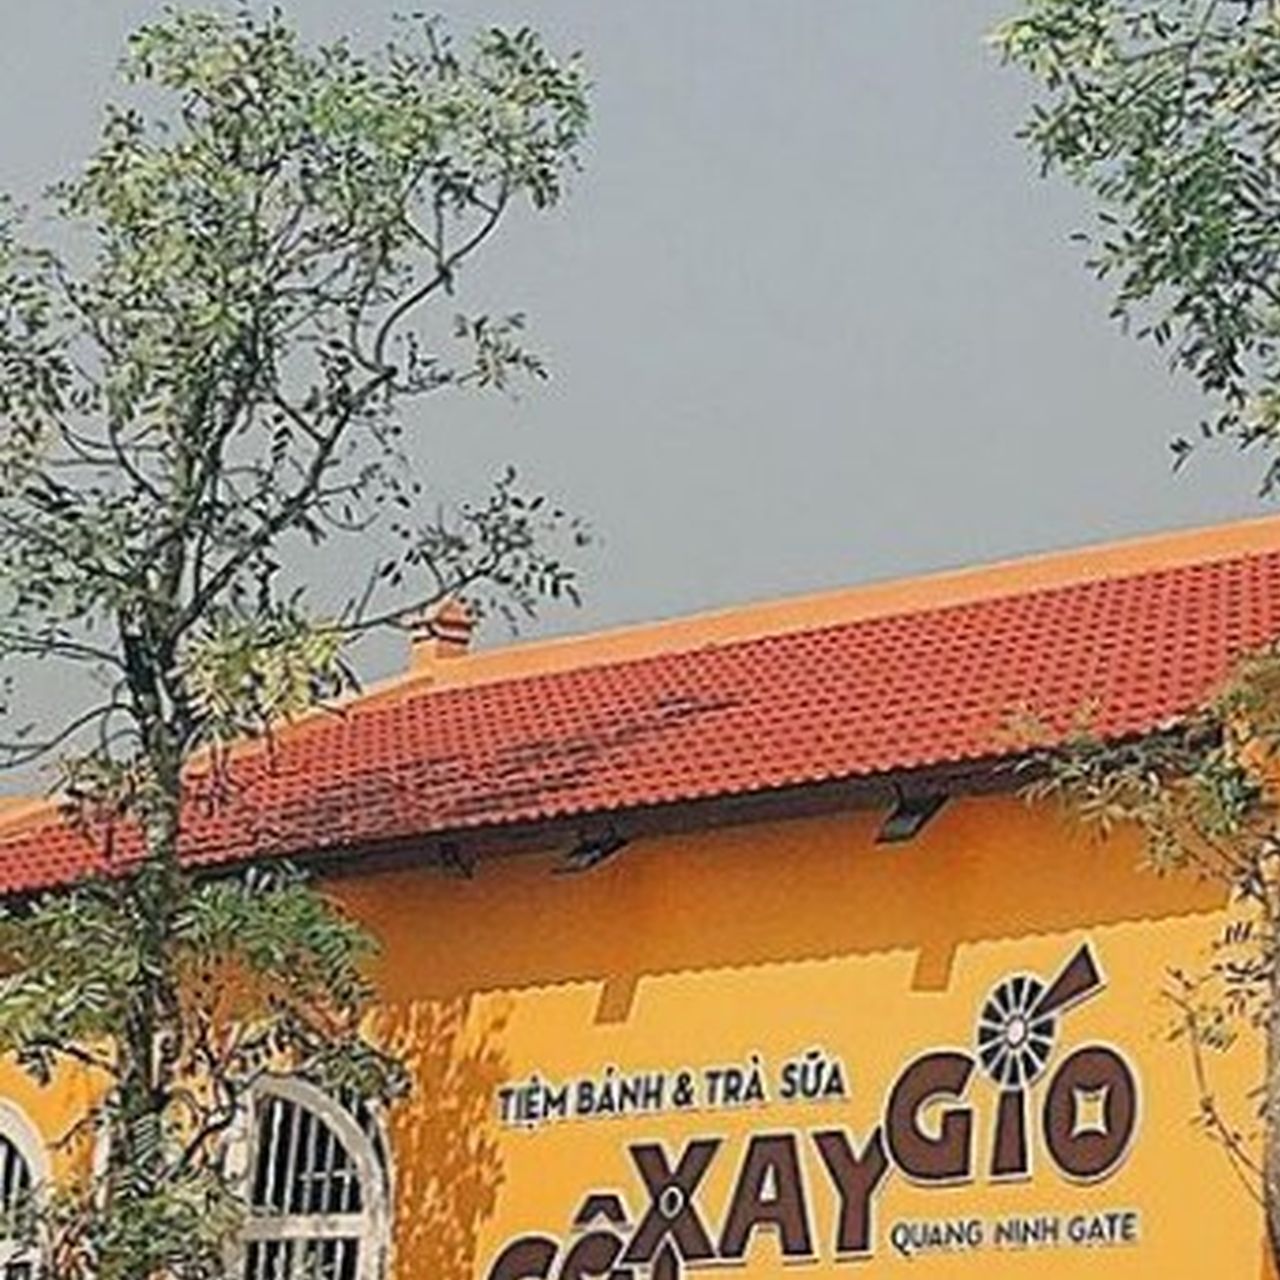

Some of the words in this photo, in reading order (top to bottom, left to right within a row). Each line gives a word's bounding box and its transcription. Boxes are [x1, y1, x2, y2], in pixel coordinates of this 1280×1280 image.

[498, 1073, 568, 1130] TIỆM
[576, 1066, 665, 1115] BÁNH
[672, 1071, 694, 1107] &
[704, 1054, 765, 1105] TRÀ
[779, 1050, 845, 1099] SỮA
[619, 1126, 890, 1263] XAY
[890, 1220, 983, 1257] QUANG
[994, 1216, 1059, 1245] NINH
[1067, 1212, 1137, 1243] GATE
